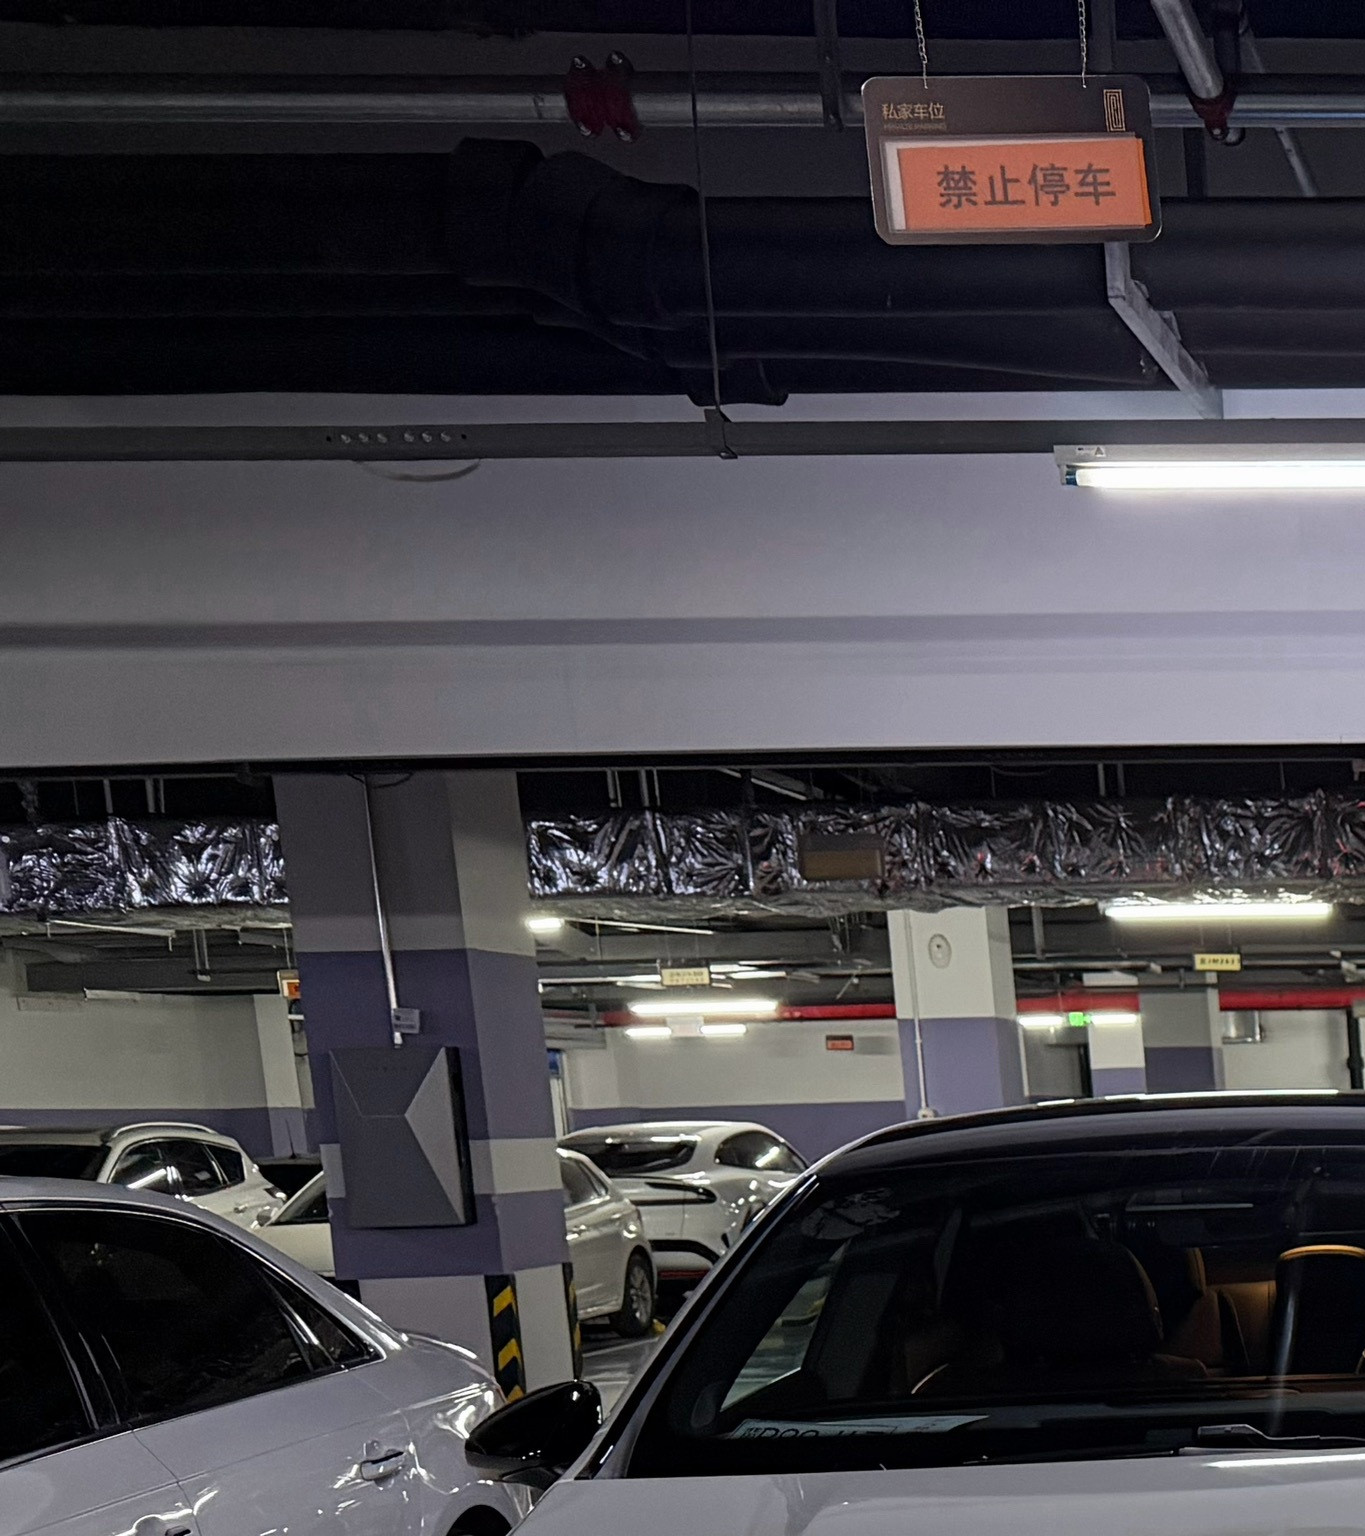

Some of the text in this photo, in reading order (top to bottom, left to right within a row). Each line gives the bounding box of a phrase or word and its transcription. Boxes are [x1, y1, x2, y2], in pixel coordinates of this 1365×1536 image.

[882, 103, 944, 119] 私家车位
[937, 163, 1115, 209] 禁止停车
